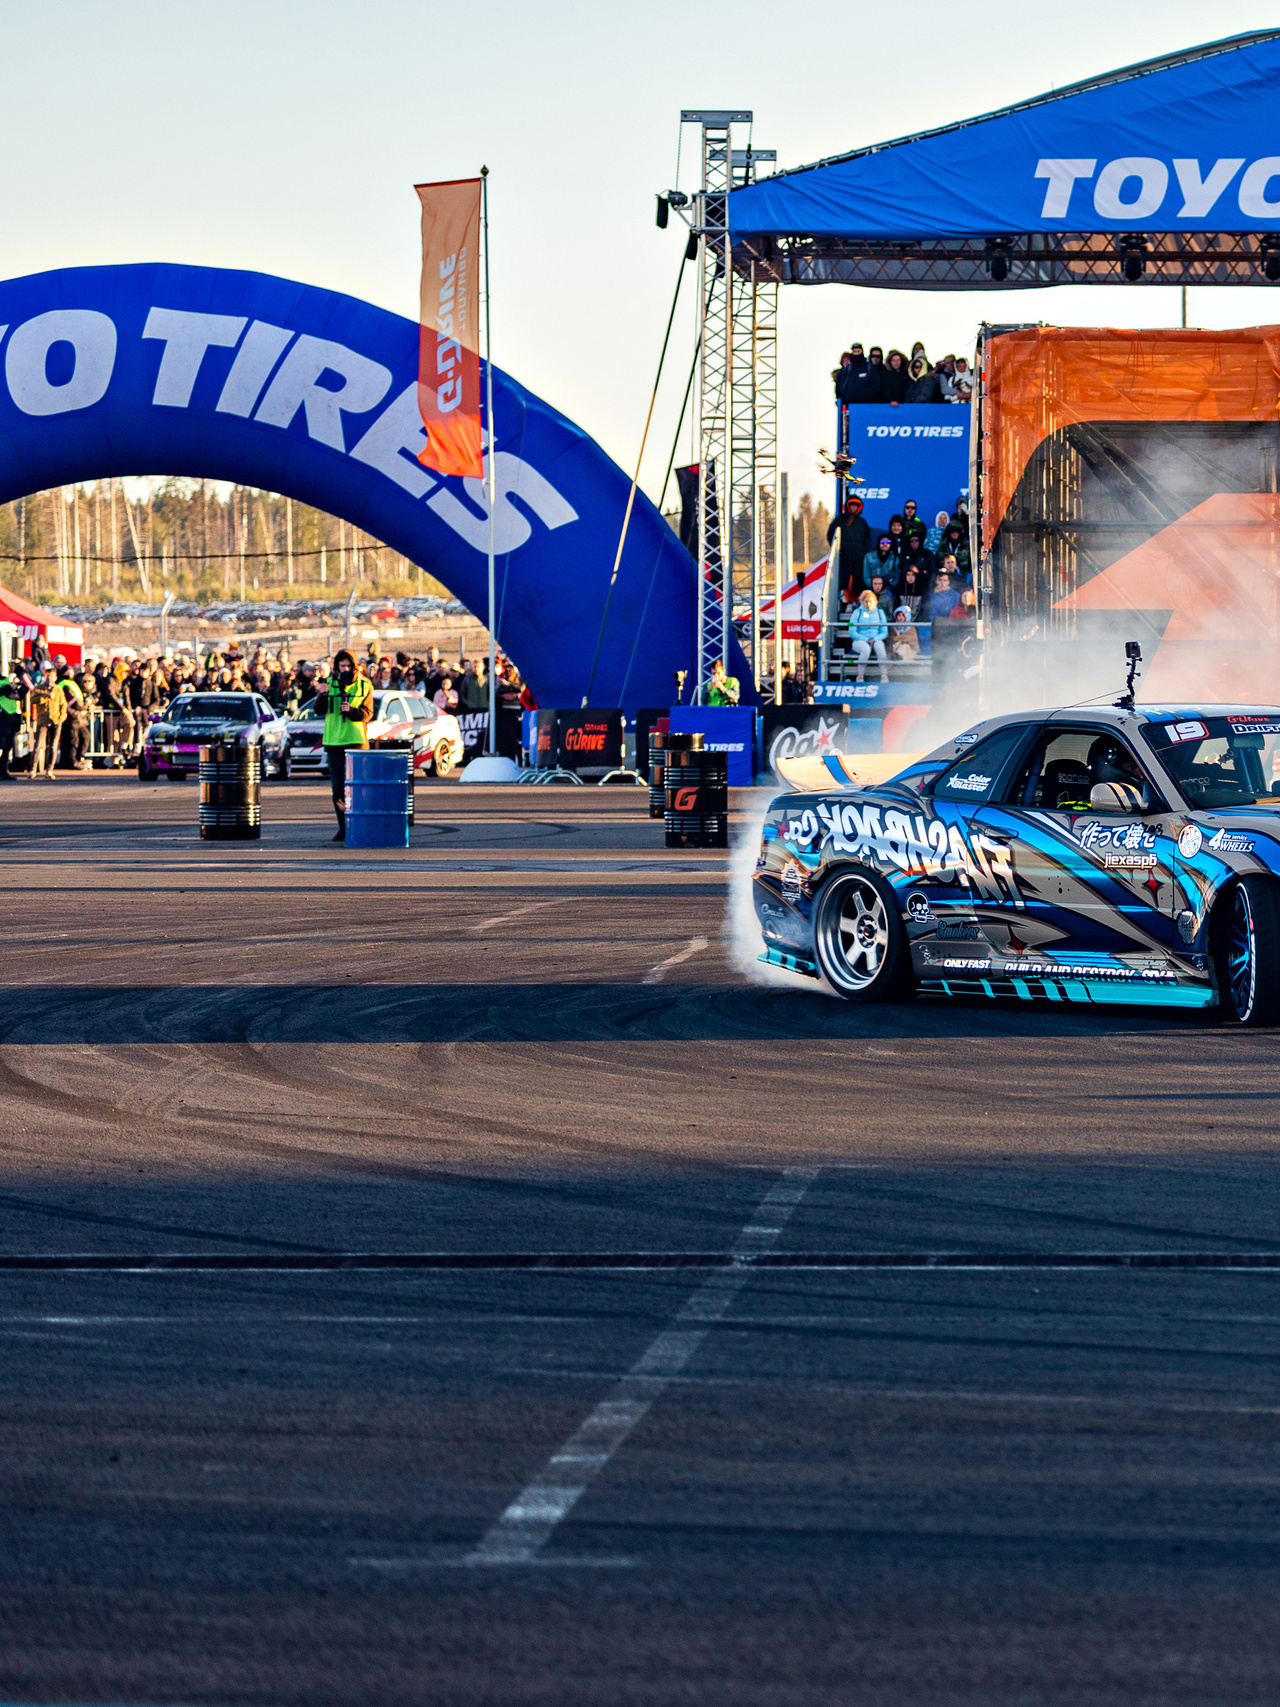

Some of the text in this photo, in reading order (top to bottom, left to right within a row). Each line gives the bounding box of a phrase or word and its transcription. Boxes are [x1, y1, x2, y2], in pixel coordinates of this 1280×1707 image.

[142, 306, 579, 556] TIRES
[867, 426, 963, 437] TOYO TIRES
[849, 487, 890, 499] IRES
[825, 685, 879, 698] TIRES
[1165, 720, 1207, 743] 19
[709, 743, 745, 752] TIRES
[968, 774, 991, 783] Color
[1058, 773, 1090, 783] sparco
[953, 781, 987, 792] Blaster
[1208, 827, 1225, 851] 4
[1220, 841, 1255, 852] WHEELS
[936, 920, 979, 940] Smokers
[944, 959, 991, 969] ONLY FAST
[1043, 966, 1071, 980] AND
